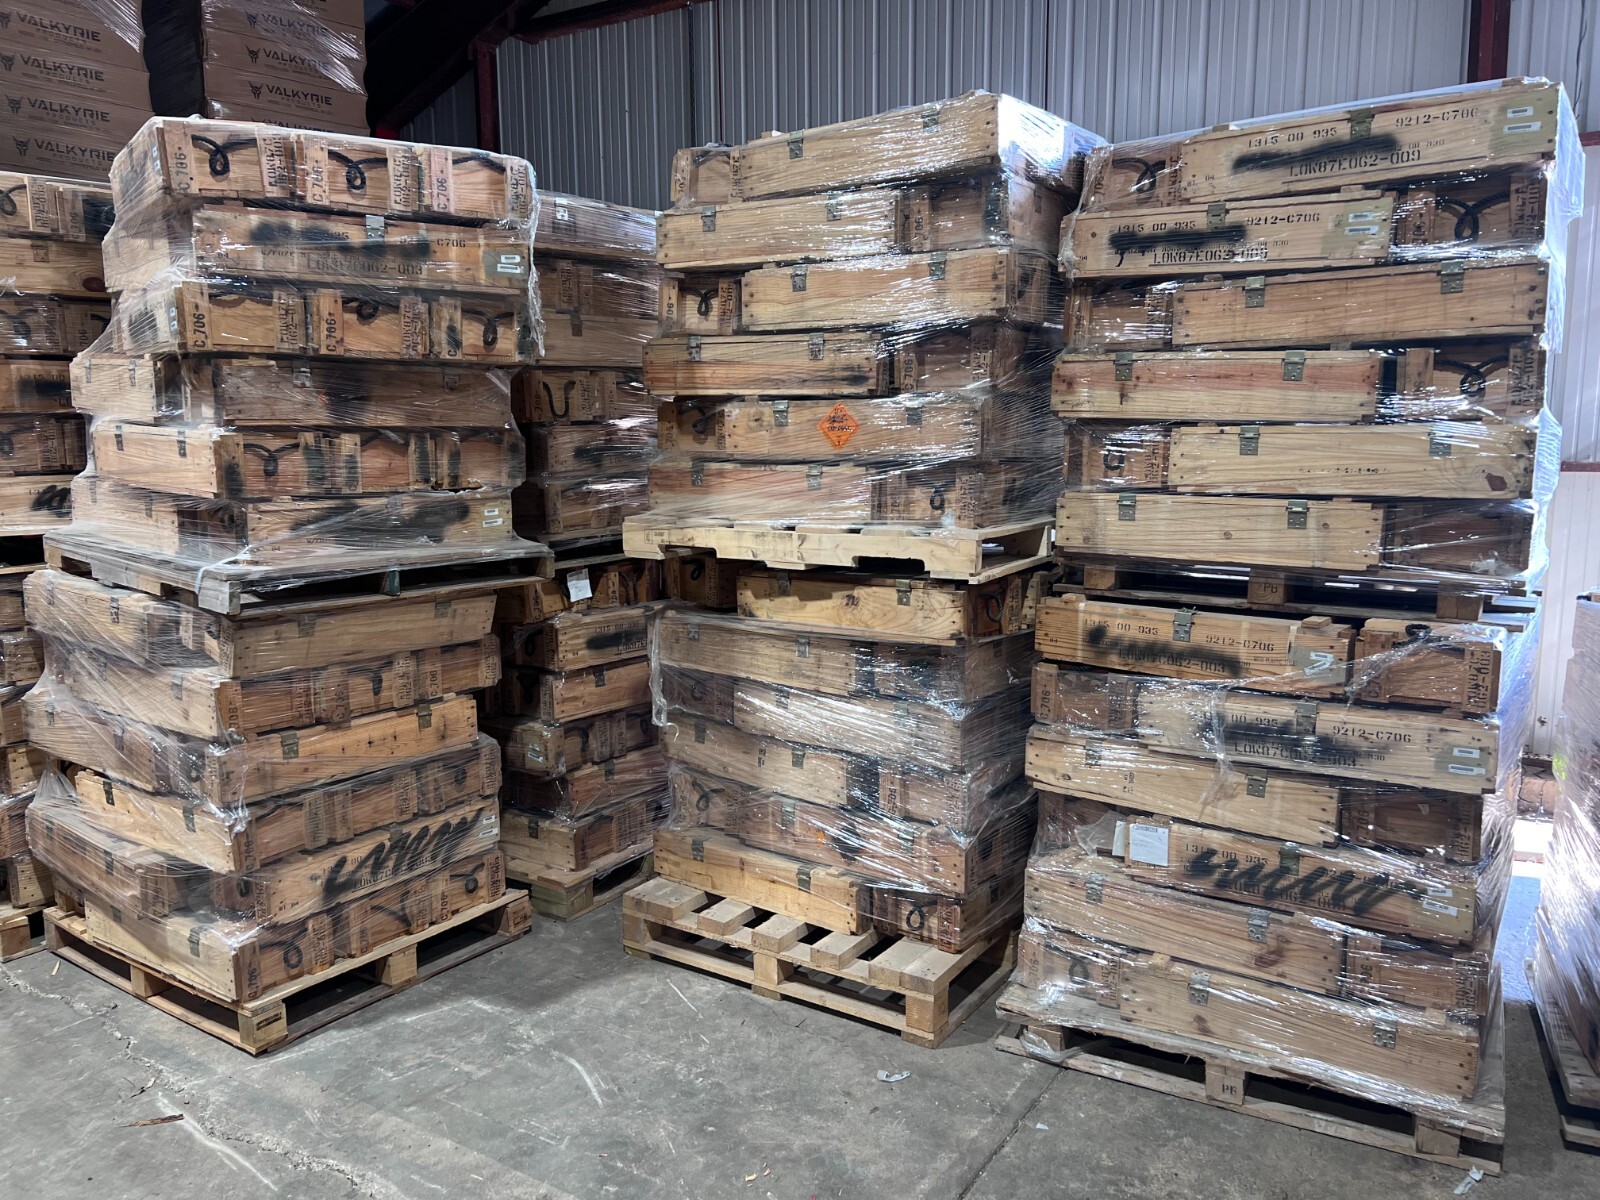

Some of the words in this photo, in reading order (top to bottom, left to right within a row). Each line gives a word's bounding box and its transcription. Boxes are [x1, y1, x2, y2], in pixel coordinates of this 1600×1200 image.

[16, 10, 101, 41] VALKYRIE
[261, 13, 329, 35] VALKYRIE
[20, 53, 104, 83] VALKYRIE
[263, 48, 332, 71] VALKYRIE
[266, 84, 333, 105] VALKYRIE
[27, 97, 111, 122] VALKYRIE
[1248, 135, 1279, 149] 1315
[1287, 132, 1305, 144] 00
[1313, 127, 1338, 139] 935
[1395, 107, 1479, 128] 9212-C706
[34, 138, 115, 162] VALKYRIE
[175, 153, 188, 177] 706
[436, 178, 447, 200] 706
[1117, 224, 1145, 234] 1315
[1152, 222, 1167, 231] 00
[1174, 221, 1196, 230] 935
[1246, 212, 1320, 226] 9212-C706
[665, 303, 674, 321] 706
[193, 313, 205, 336] 706
[326, 318, 336, 336] 706
[53, 373, 65, 382] 00
[903, 357, 914, 382] 706
[1117, 622, 1131, 632] 00
[1138, 625, 1159, 636] 935
[1205, 633, 1275, 653] 9212-C706
[1040, 690, 1051, 708] 706
[1231, 713, 1247, 724] 00
[1256, 717, 1279, 728] 935
[1332, 724, 1412, 744] 9212-C706
[1356, 810, 1369, 831] 706
[1221, 850, 1238, 860] 00
[1246, 853, 1269, 866] 935
[440, 894, 449, 912] 706
[248, 967, 258, 988] 706
